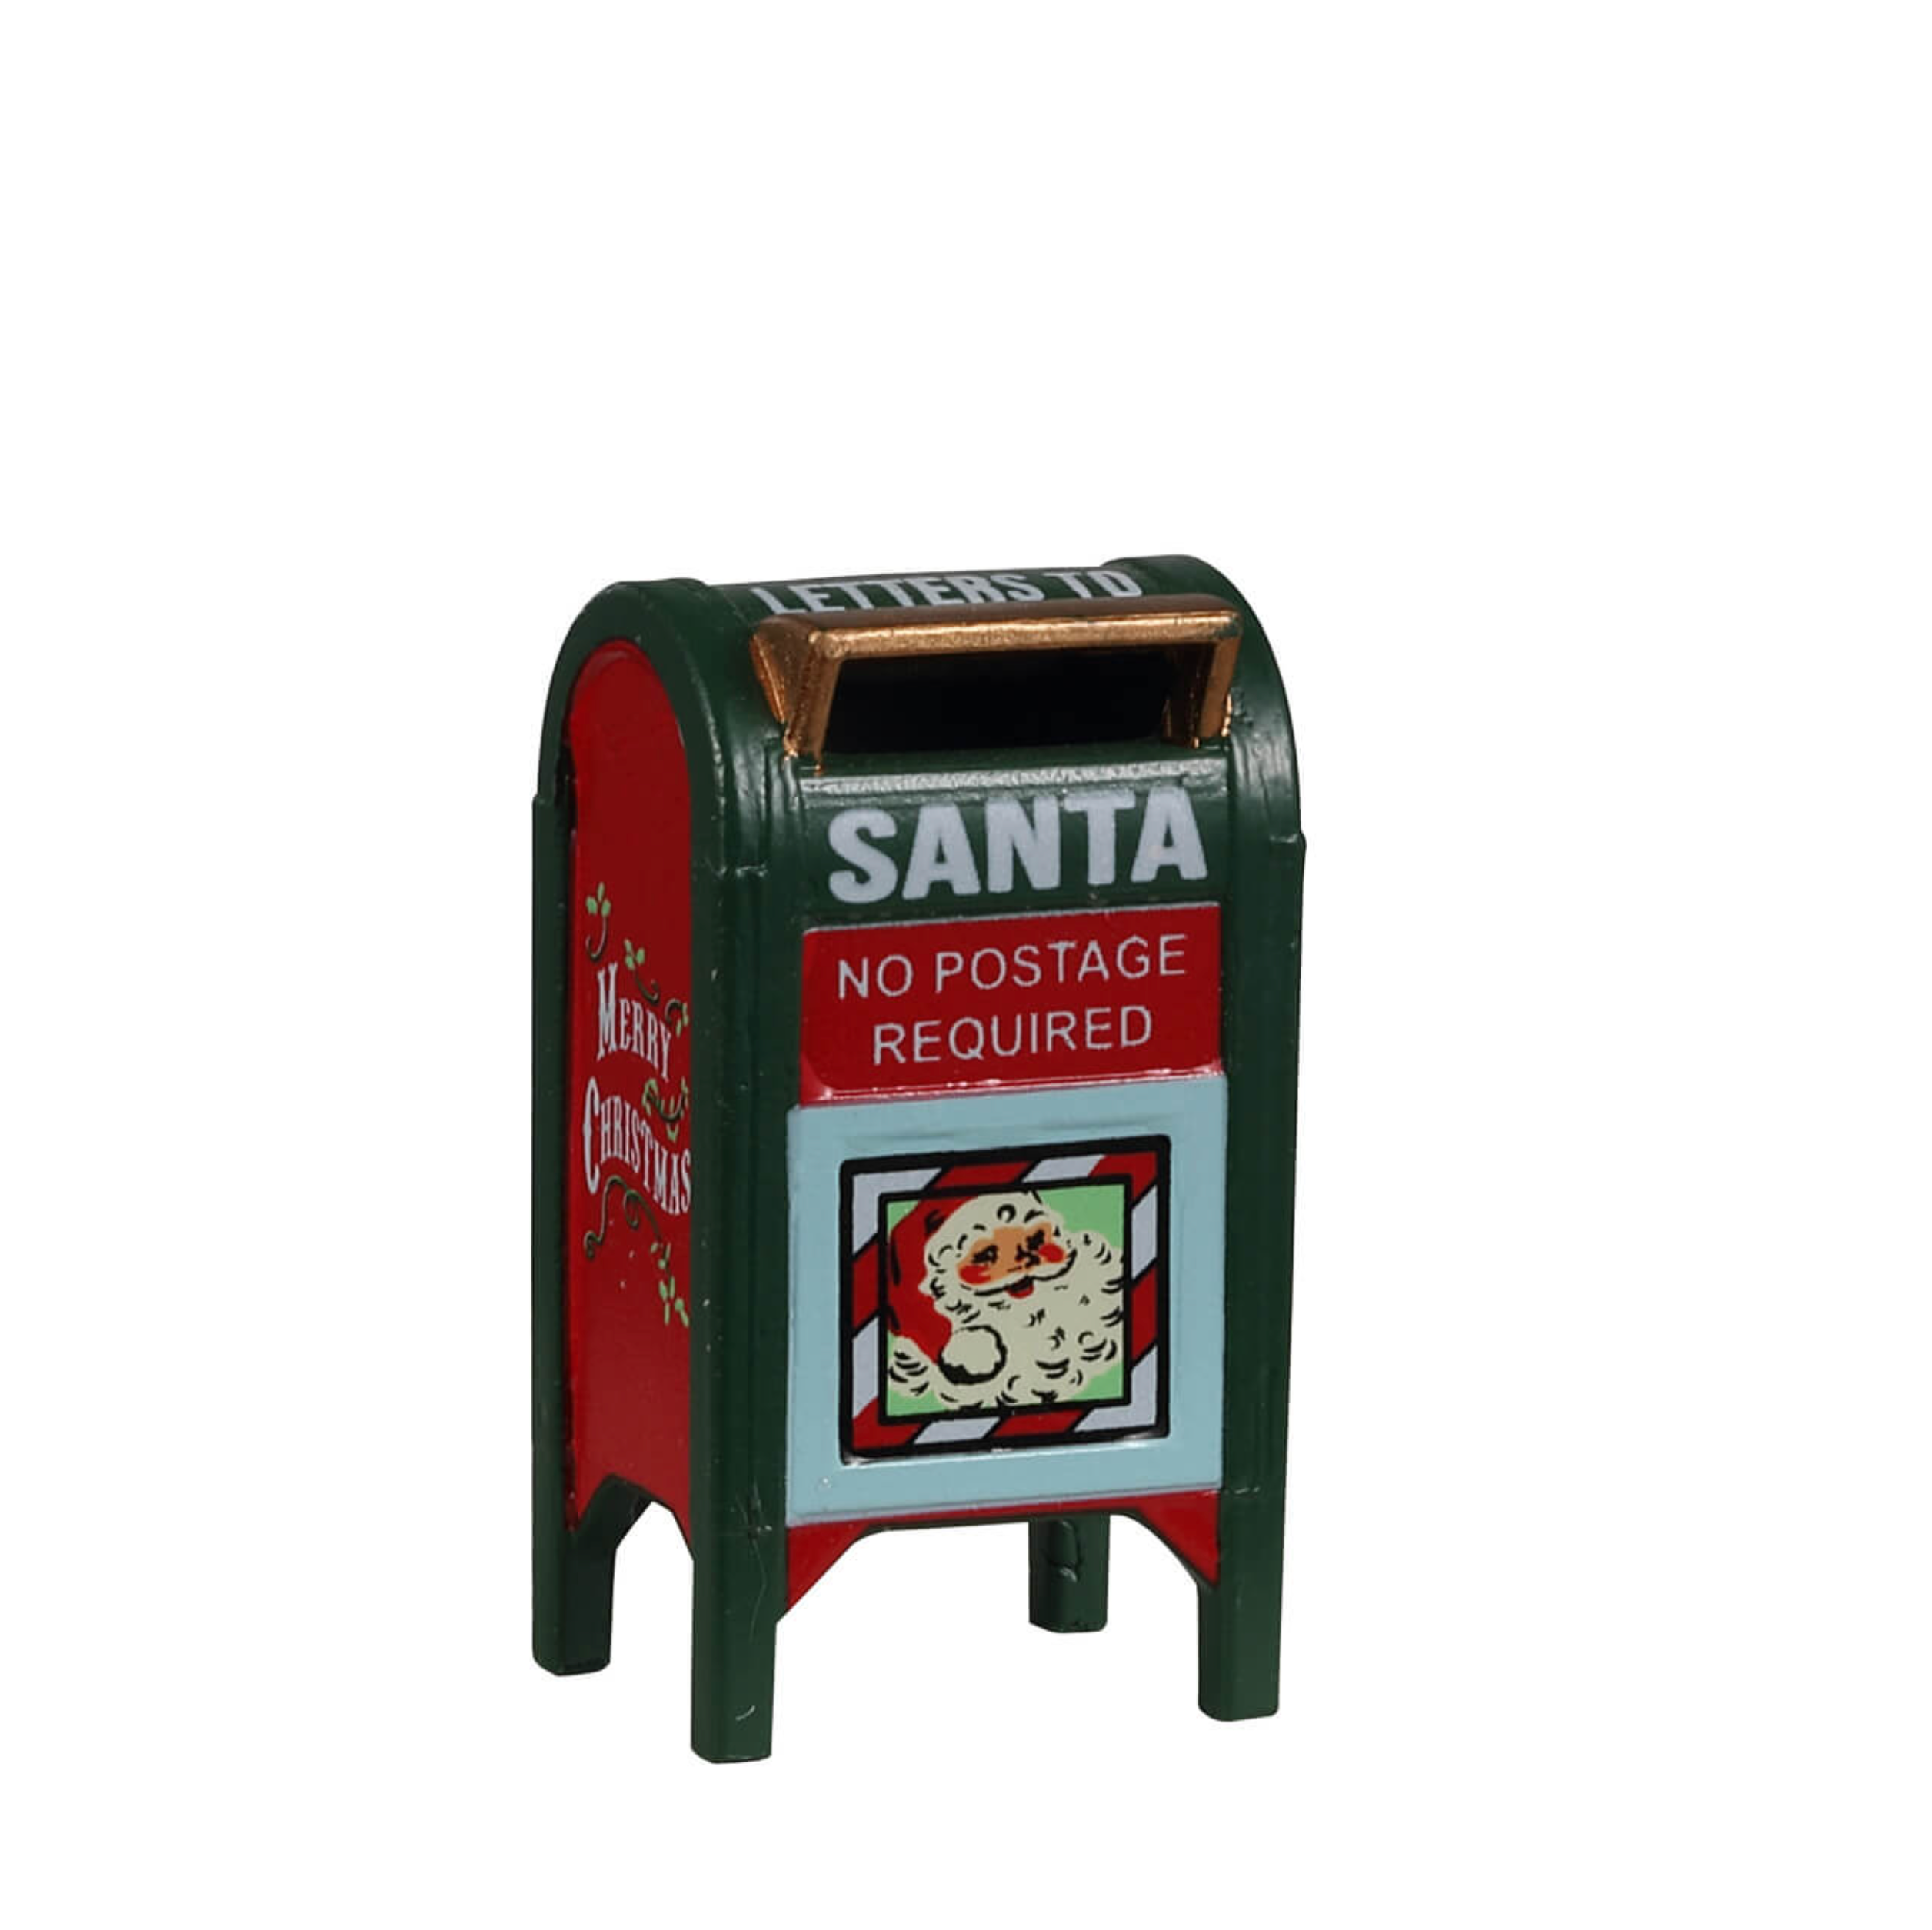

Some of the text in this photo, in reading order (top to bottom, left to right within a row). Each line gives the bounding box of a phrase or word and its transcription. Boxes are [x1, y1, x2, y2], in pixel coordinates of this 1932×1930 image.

[752, 573, 1044, 614] LETTERS
[828, 786, 1208, 904] SANTA
[838, 933, 1188, 1000] NO POSTAGE
[597, 962, 672, 1082] MERRY
[873, 1005, 1153, 1066] REQUIRED
[583, 1076, 691, 1216] CHRISTMAS
